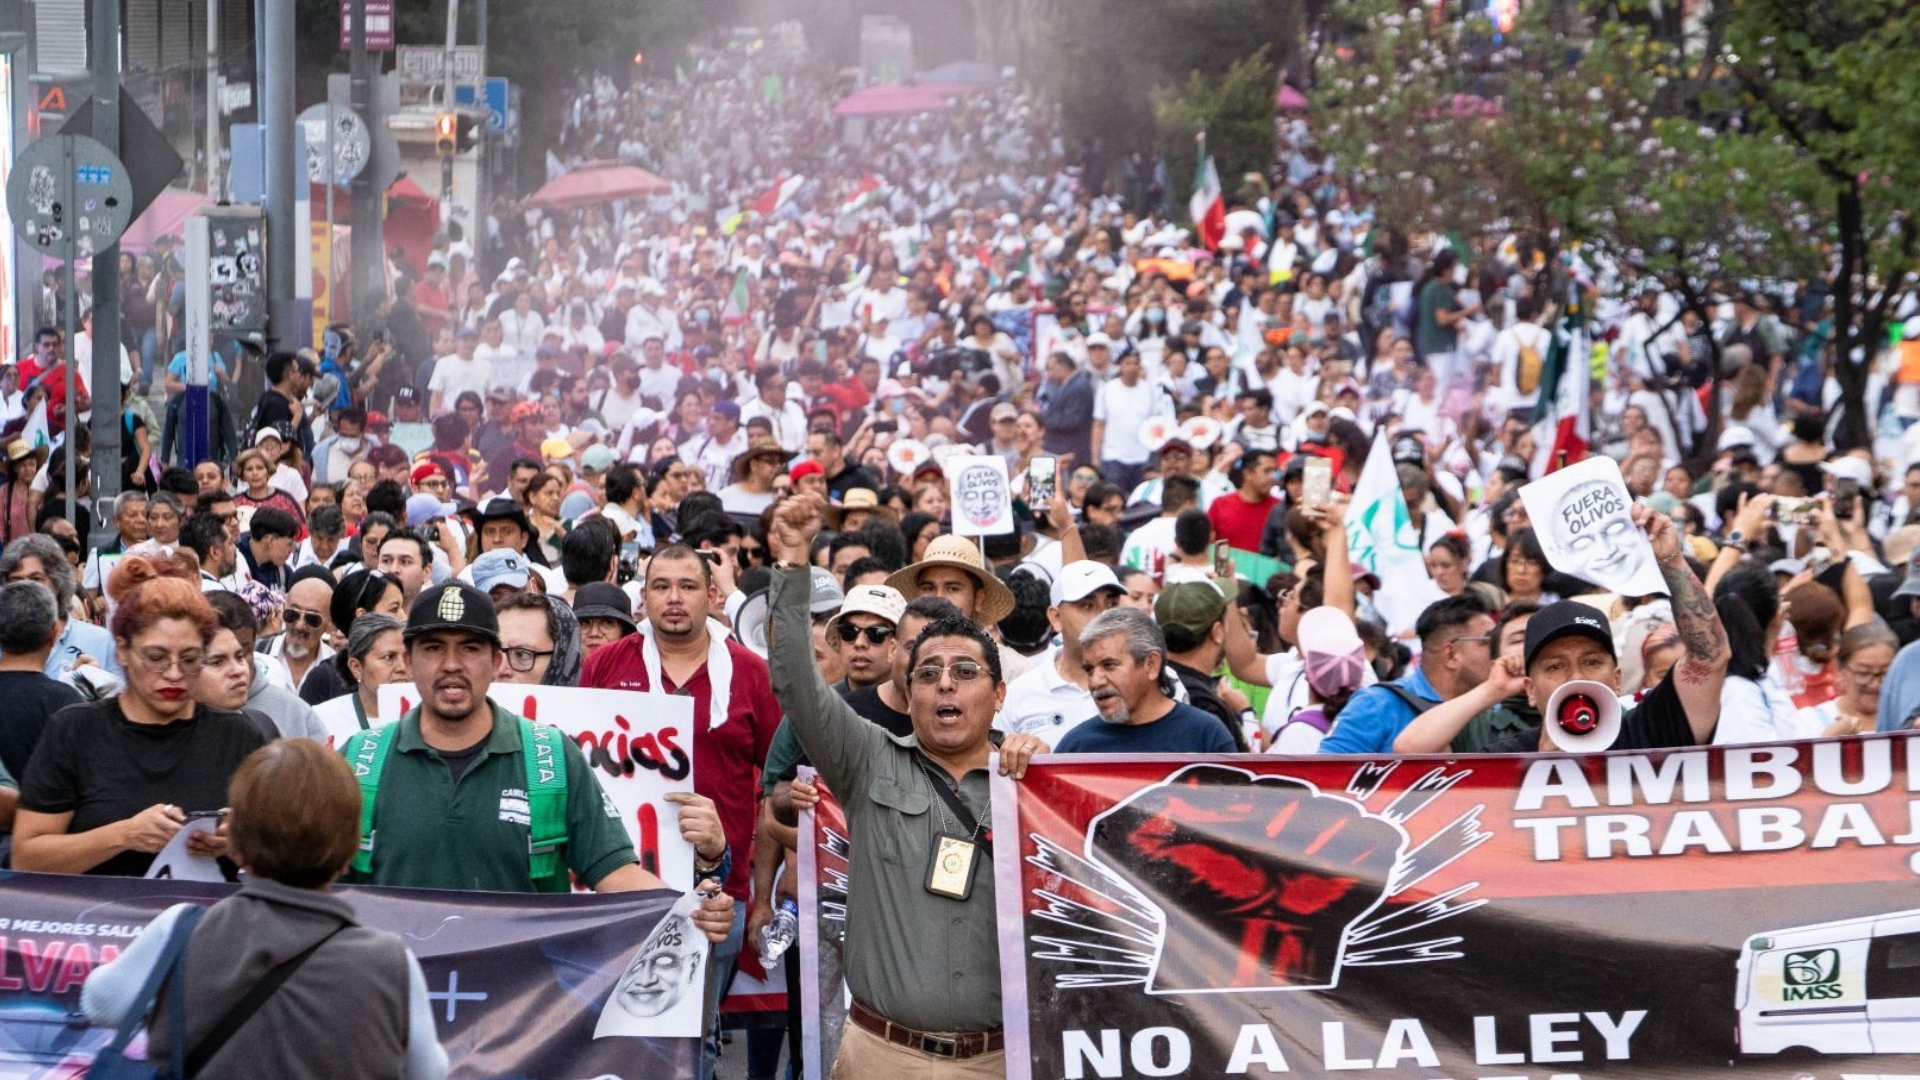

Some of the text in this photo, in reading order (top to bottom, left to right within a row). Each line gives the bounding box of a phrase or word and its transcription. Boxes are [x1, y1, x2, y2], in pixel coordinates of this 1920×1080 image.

[967, 471, 994, 480] FUERA
[968, 480, 998, 488] OLIVOS
[1562, 486, 1615, 524] FUERA
[1569, 498, 1625, 535] OLIVOS
[11, 920, 97, 936] MEJORES
[1782, 983, 1843, 1002] IMSS
[1062, 1009, 1648, 1080] NO A LA LEY
